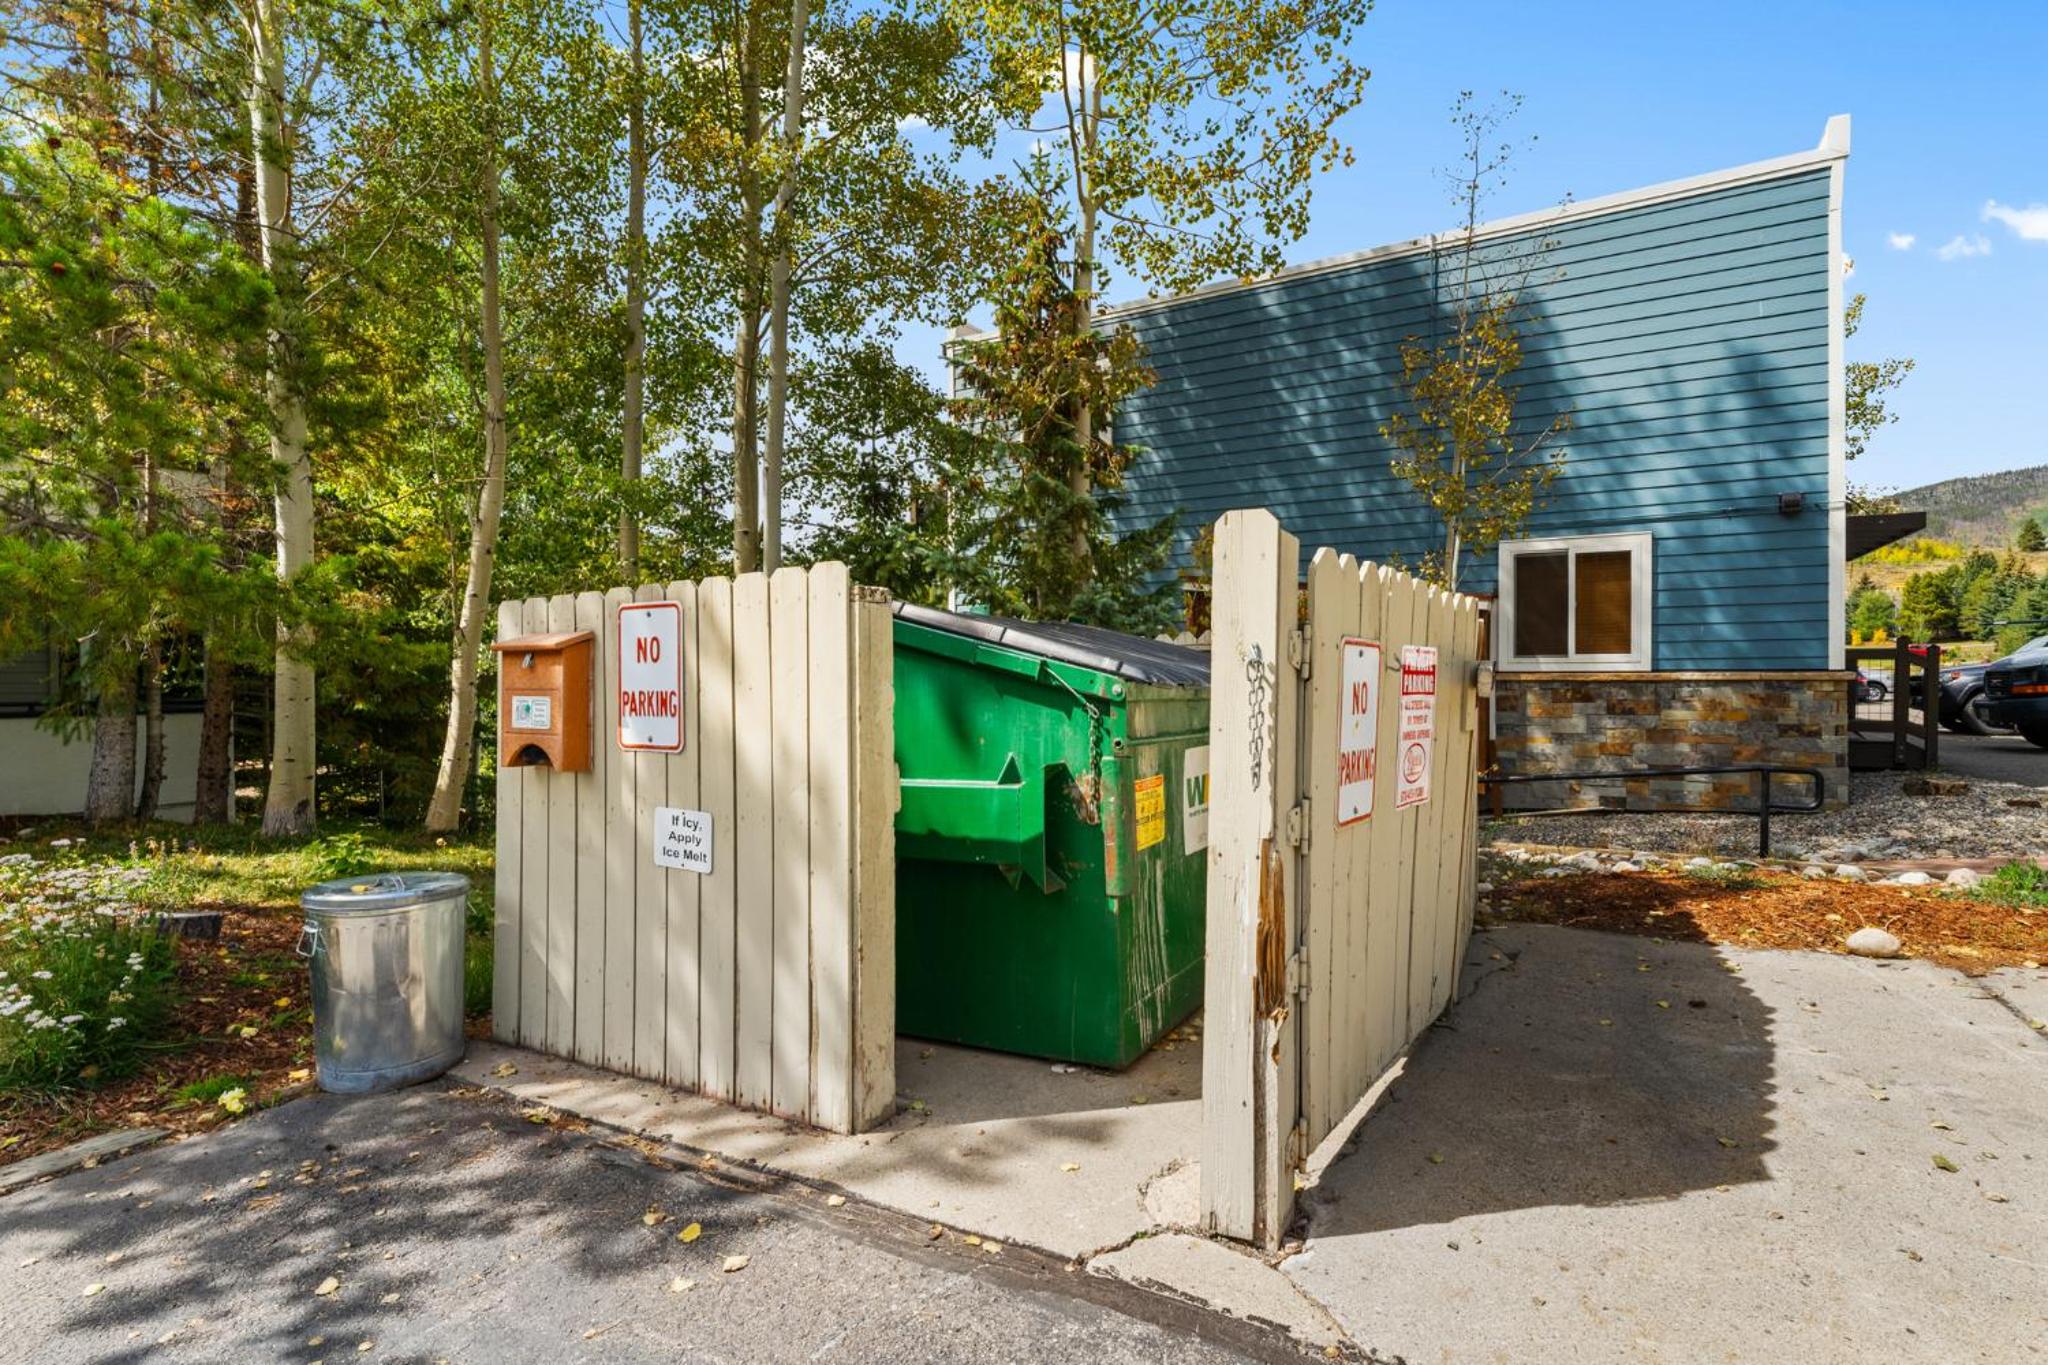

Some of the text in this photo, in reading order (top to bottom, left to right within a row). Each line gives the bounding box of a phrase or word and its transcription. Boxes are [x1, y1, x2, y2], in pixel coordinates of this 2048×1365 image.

[636, 636, 661, 664] NO
[623, 691, 677, 718] PARKING
[1352, 681, 1368, 715] NO
[1340, 748, 1375, 786] PARKING
[672, 815, 679, 826] If
[668, 831, 702, 847] Apply
[662, 846, 708, 863] Ice Melt
